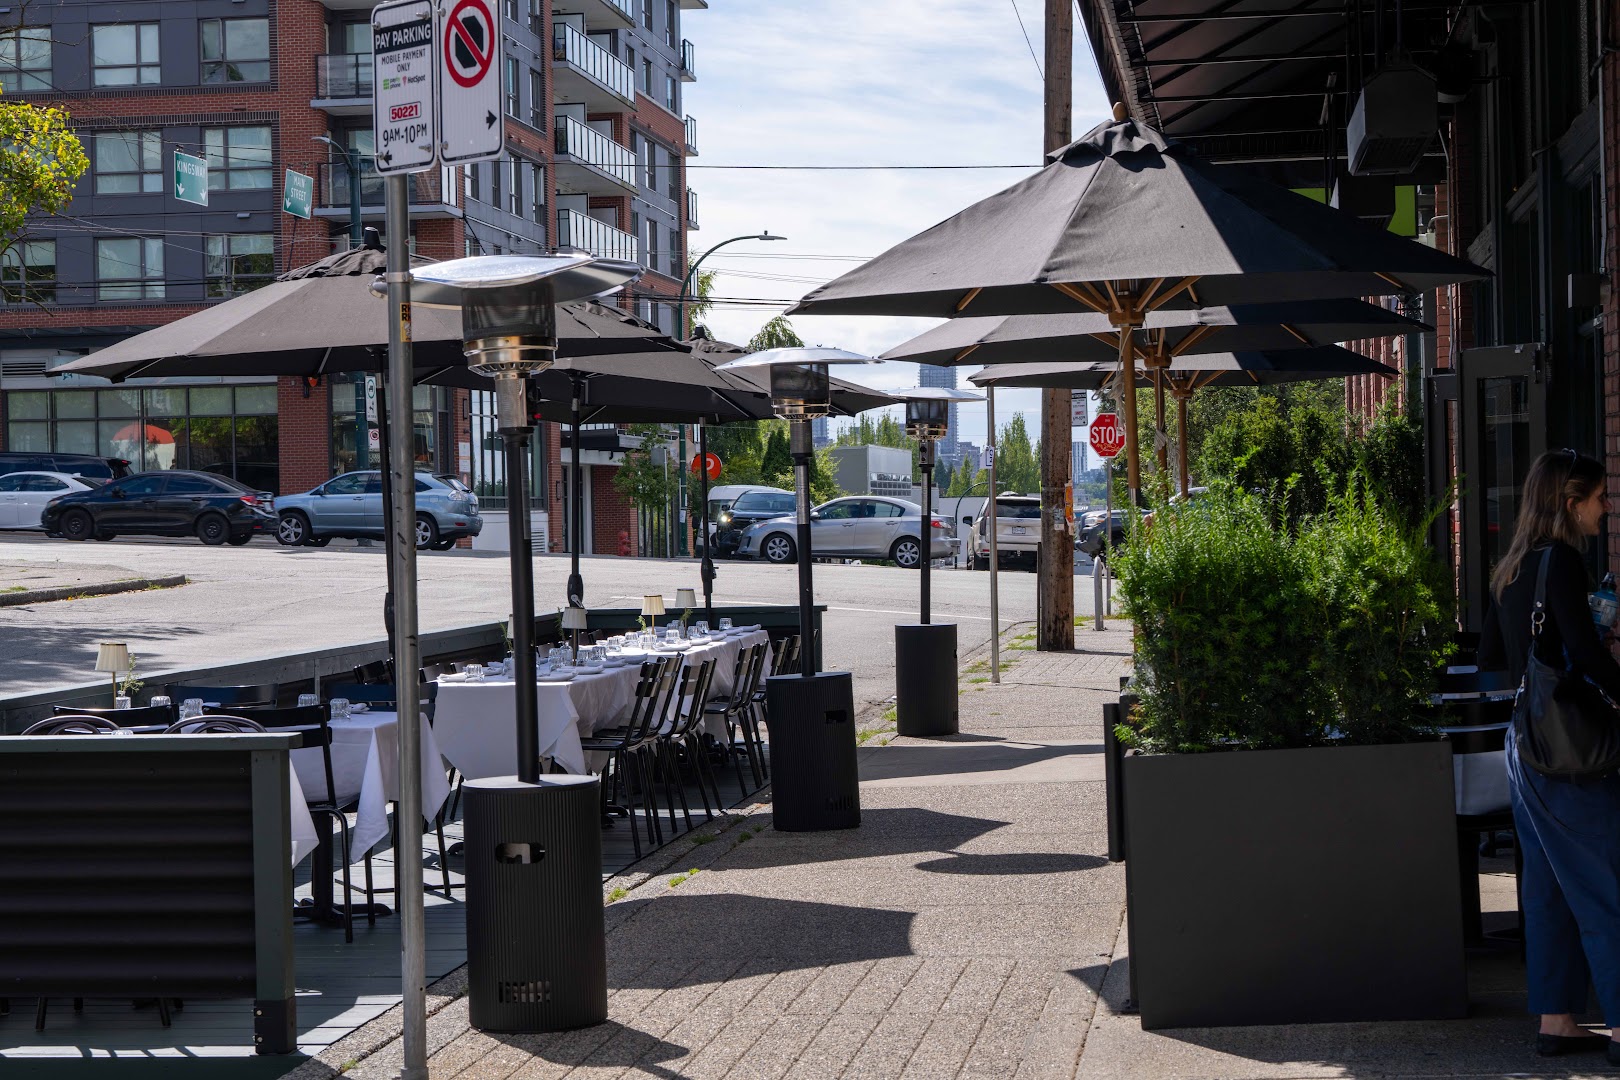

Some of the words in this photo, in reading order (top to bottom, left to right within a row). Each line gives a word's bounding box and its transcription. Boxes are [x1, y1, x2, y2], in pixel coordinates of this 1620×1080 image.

[375, 34, 391, 50] PAY
[392, 23, 431, 45] PARKING
[381, 54, 401, 65] MOBILE
[402, 48, 426, 62] PAYMENT
[397, 62, 411, 73] ONLY
[391, 104, 418, 120] 50221
[383, 123, 427, 147] 9AM-10PM
[176, 160, 206, 178] KINGSWAY
[293, 175, 306, 188] MAIN
[290, 188, 307, 201] STREET
[1091, 426, 1125, 444] STOP
